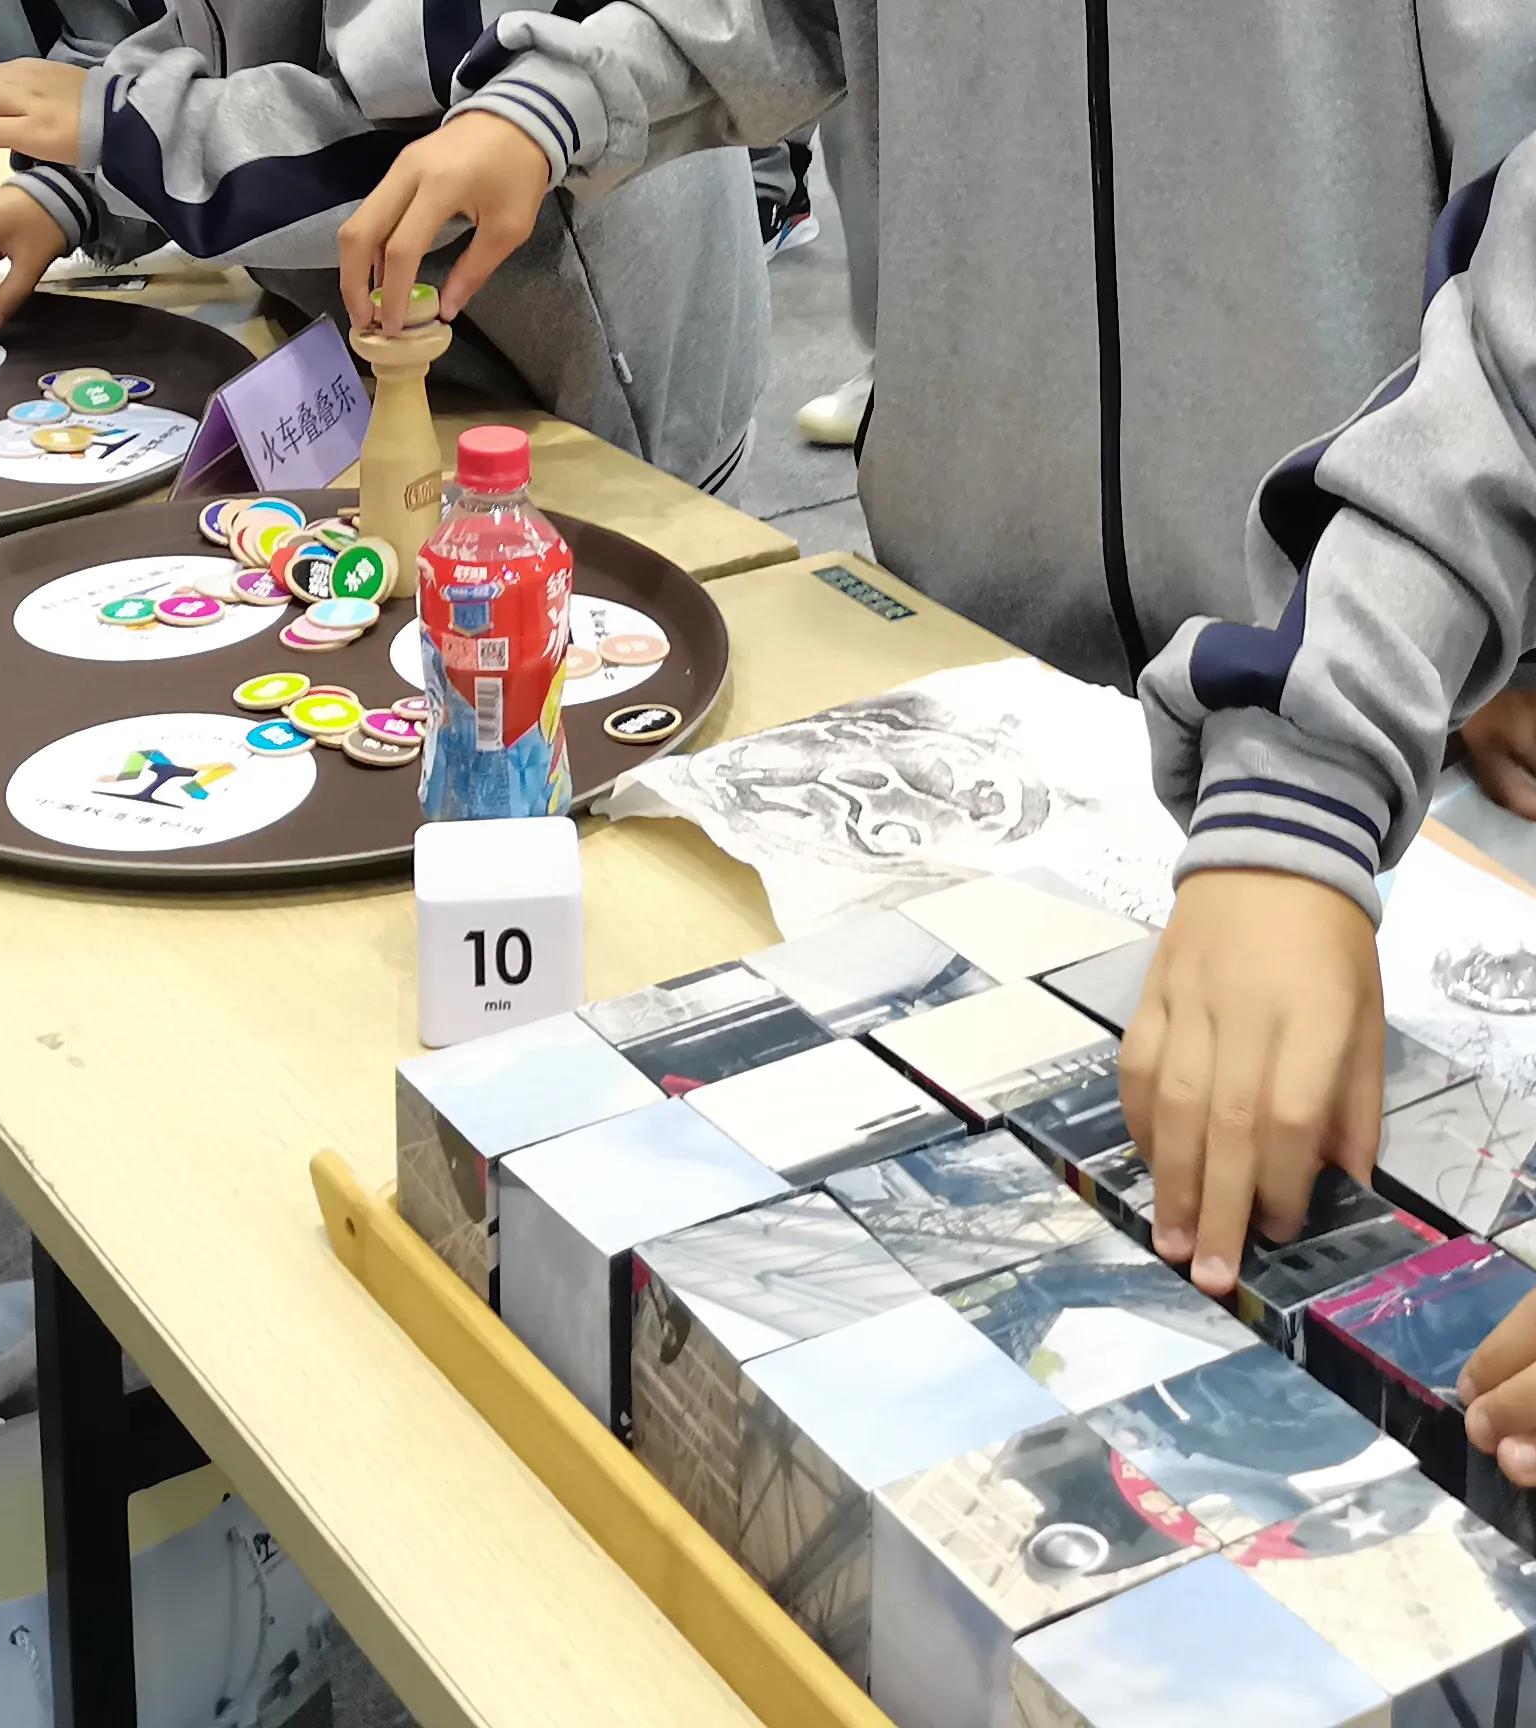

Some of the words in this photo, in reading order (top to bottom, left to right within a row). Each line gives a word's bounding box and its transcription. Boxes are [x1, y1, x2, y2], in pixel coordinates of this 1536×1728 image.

[260, 374, 356, 473] 火车叠叠乐
[463, 927, 532, 987] 10
[484, 999, 512, 1012] min
